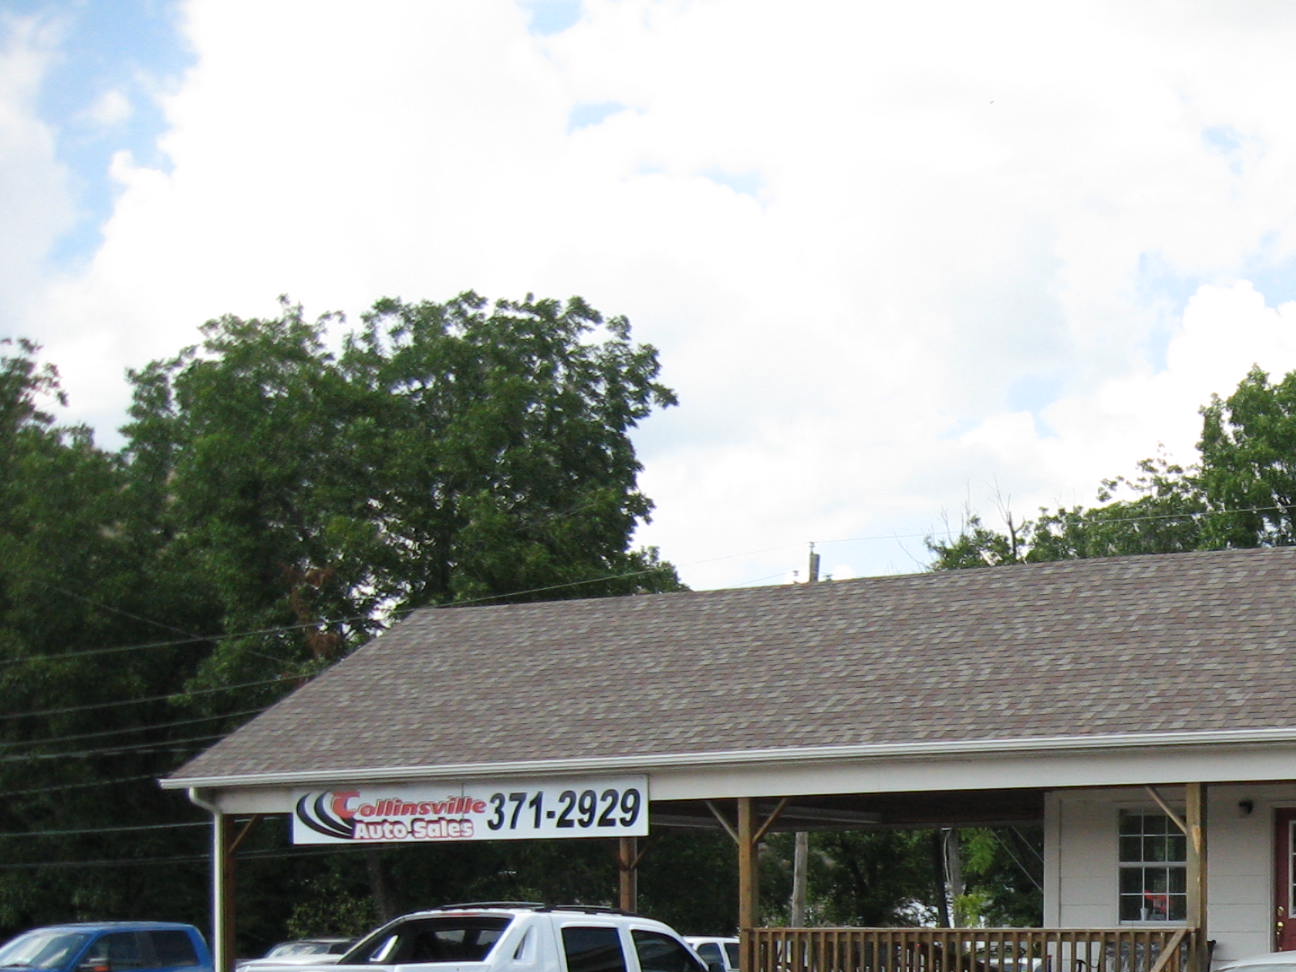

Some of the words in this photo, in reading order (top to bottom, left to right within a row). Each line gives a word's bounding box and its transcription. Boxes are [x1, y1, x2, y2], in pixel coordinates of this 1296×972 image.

[332, 792, 487, 819] Collinsville
[486, 788, 641, 830] 371-2929
[354, 820, 407, 840] Auto
[412, 818, 474, 839] Sales
